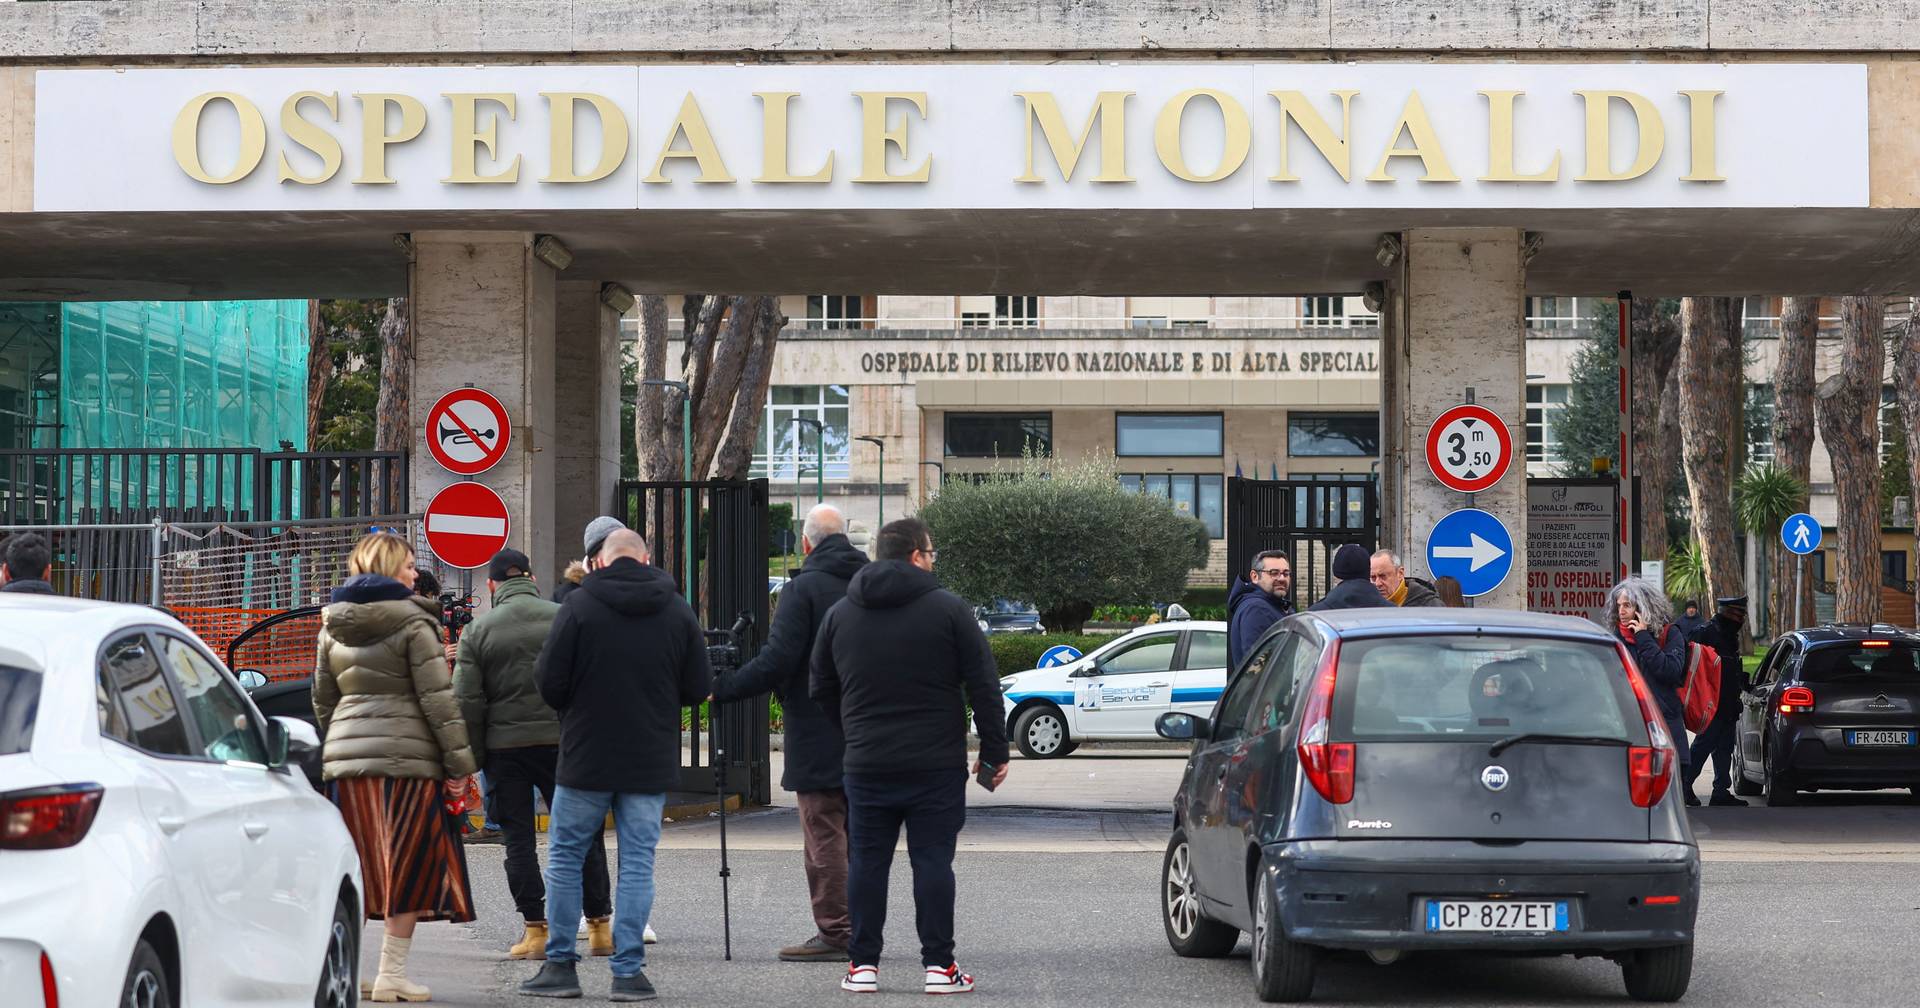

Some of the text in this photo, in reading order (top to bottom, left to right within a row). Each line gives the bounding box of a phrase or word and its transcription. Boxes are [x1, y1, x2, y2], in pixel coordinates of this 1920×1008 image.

[171, 88, 1727, 186] OSPEDALE MONALDI
[861, 352, 959, 373] OSPEDALE
[966, 352, 987, 373] DI
[992, 352, 1069, 373] RILIEVO
[1076, 352, 1184, 373] NAZIONALE
[1192, 352, 1203, 372] E
[1212, 352, 1232, 372] DI
[1241, 352, 1290, 372] ALTA
[1300, 352, 1378, 373] SPECIAL
[1472, 430, 1484, 441] m
[1531, 504, 1568, 512] MONALDI
[1574, 504, 1603, 512] NAPOLI
[1545, 523, 1576, 531] PAZIENTI
[1543, 532, 1572, 540] ESSERE
[1573, 532, 1610, 540] ACCETTATI
[1537, 541, 1551, 549] ORE
[1568, 541, 1586, 549] ALLE
[1588, 541, 1605, 549] 14.00
[1543, 550, 1557, 558] PER
[1563, 550, 1596, 558] RICOVERI
[1554, 571, 1612, 588] OSPEDALE
[1540, 591, 1556, 608] HA
[1561, 591, 1606, 608] PRONTO
[1102, 687, 1156, 695] Security
[1101, 694, 1150, 703] Service
[1856, 732, 1908, 743] FR 403LR
[1487, 773, 1504, 783] FIAT
[1347, 820, 1393, 829] Punto
[1443, 904, 1470, 928] CP
[1481, 904, 1552, 928] 827ET
